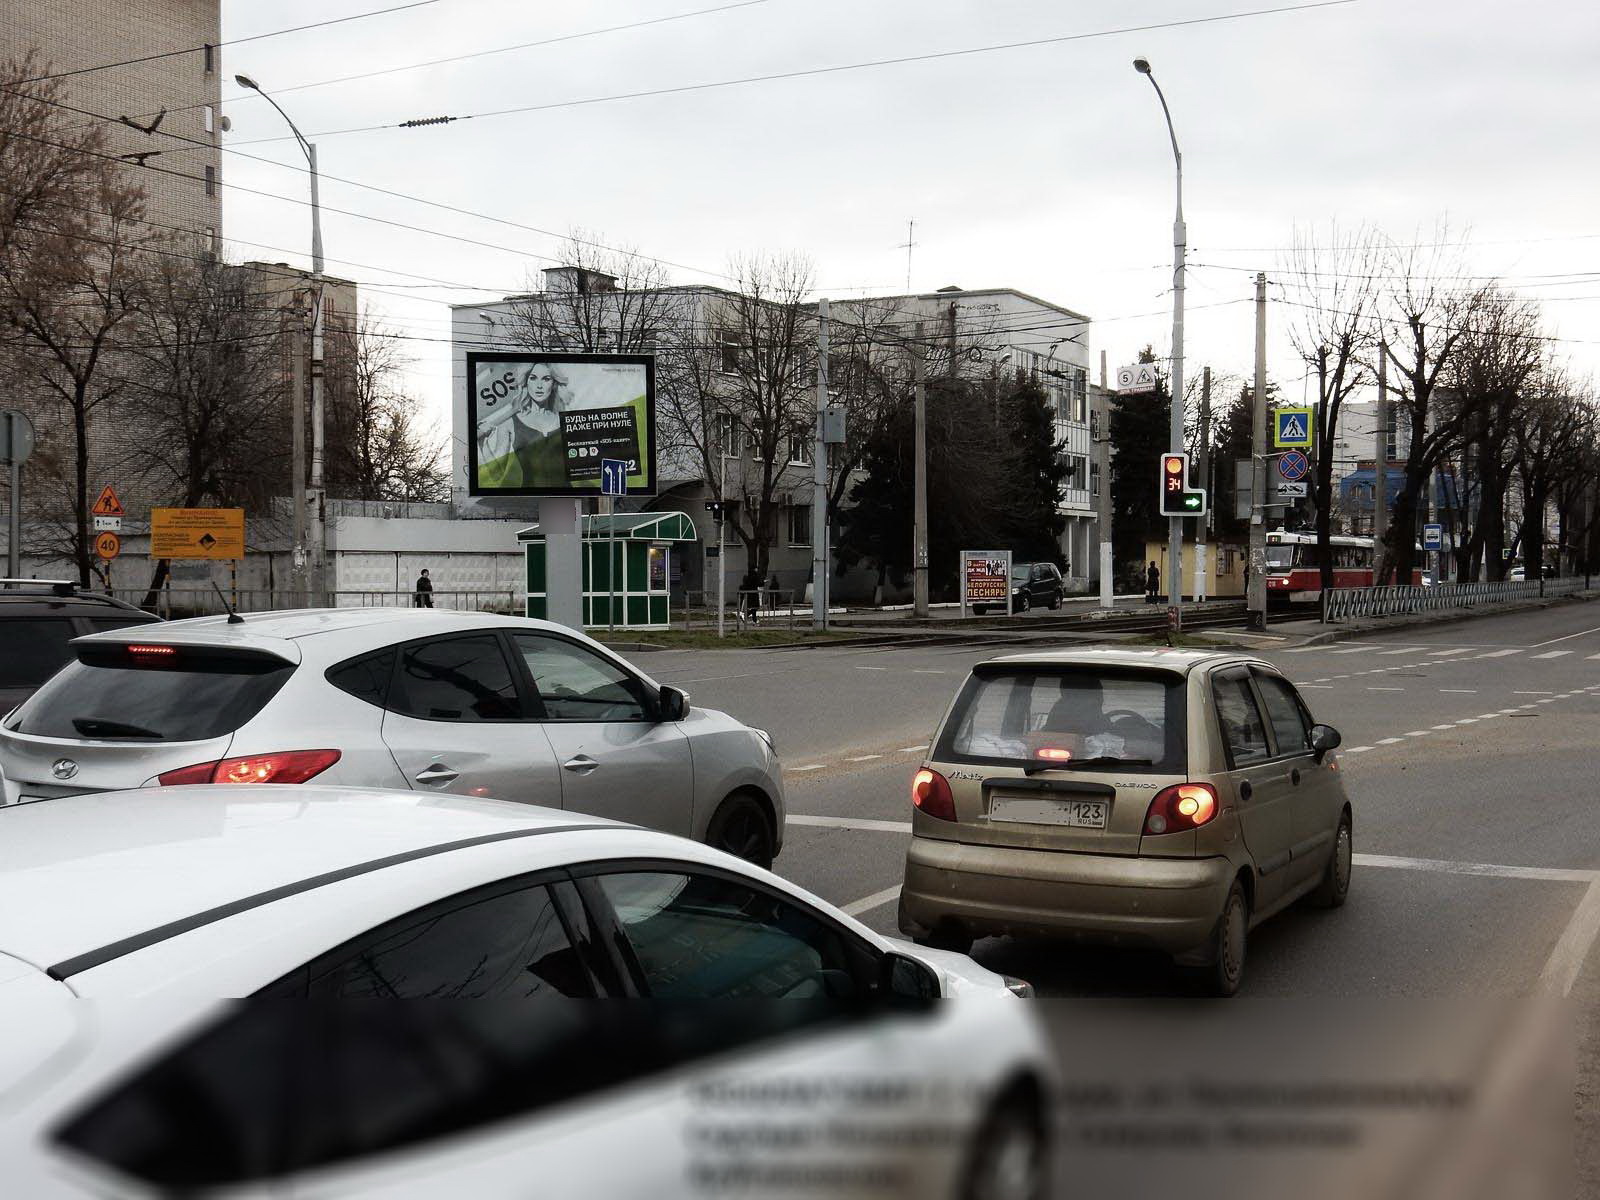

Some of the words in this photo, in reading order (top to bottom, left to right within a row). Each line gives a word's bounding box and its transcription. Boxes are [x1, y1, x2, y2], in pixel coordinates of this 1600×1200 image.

[1122, 374, 1129, 383] 5
[480, 371, 517, 407] SOS
[565, 414, 587, 424] БУДЬ
[588, 413, 600, 422] НА
[600, 411, 629, 421] ВОЛНЕ
[566, 422, 592, 433] ДАЖЕ
[592, 420, 610, 430] ПРИ
[610, 419, 632, 428] НУЛЕ
[1168, 477, 1181, 491] 34
[100, 540, 115, 551] 40
[967, 589, 1006, 597] ПЕСНЯРЫ
[948, 770, 983, 781] Matiz
[1114, 782, 1158, 790] DAEWOO
[1073, 804, 1101, 819] 123
[1077, 818, 1092, 826] RUS
